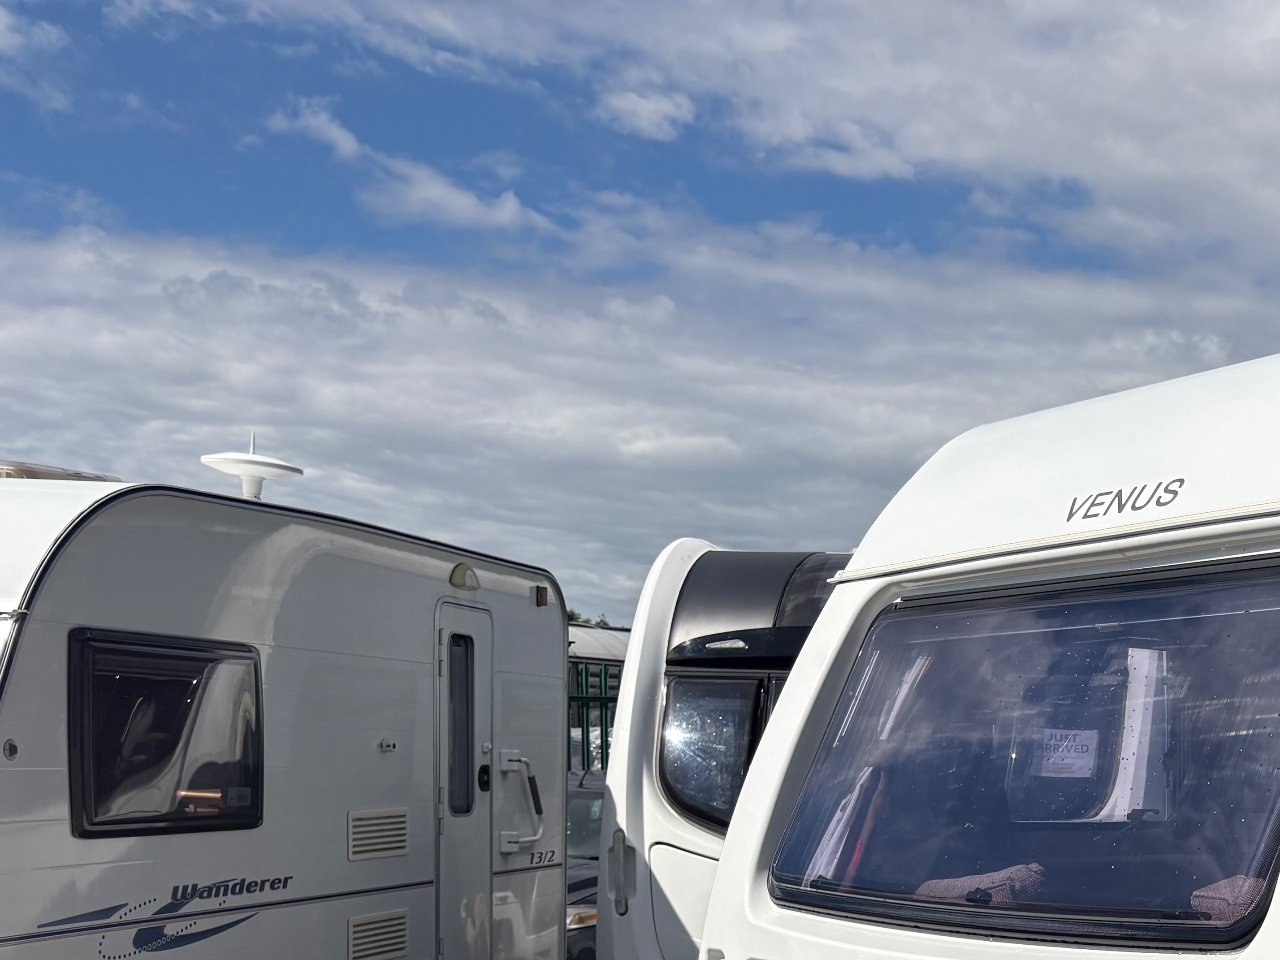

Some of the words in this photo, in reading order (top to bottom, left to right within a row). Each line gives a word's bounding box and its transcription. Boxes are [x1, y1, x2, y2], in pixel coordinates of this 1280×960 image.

[1066, 478, 1185, 522] VENUS
[1047, 732, 1081, 743] JUST
[529, 850, 555, 865] 13/2
[171, 876, 293, 901] Wanderer
